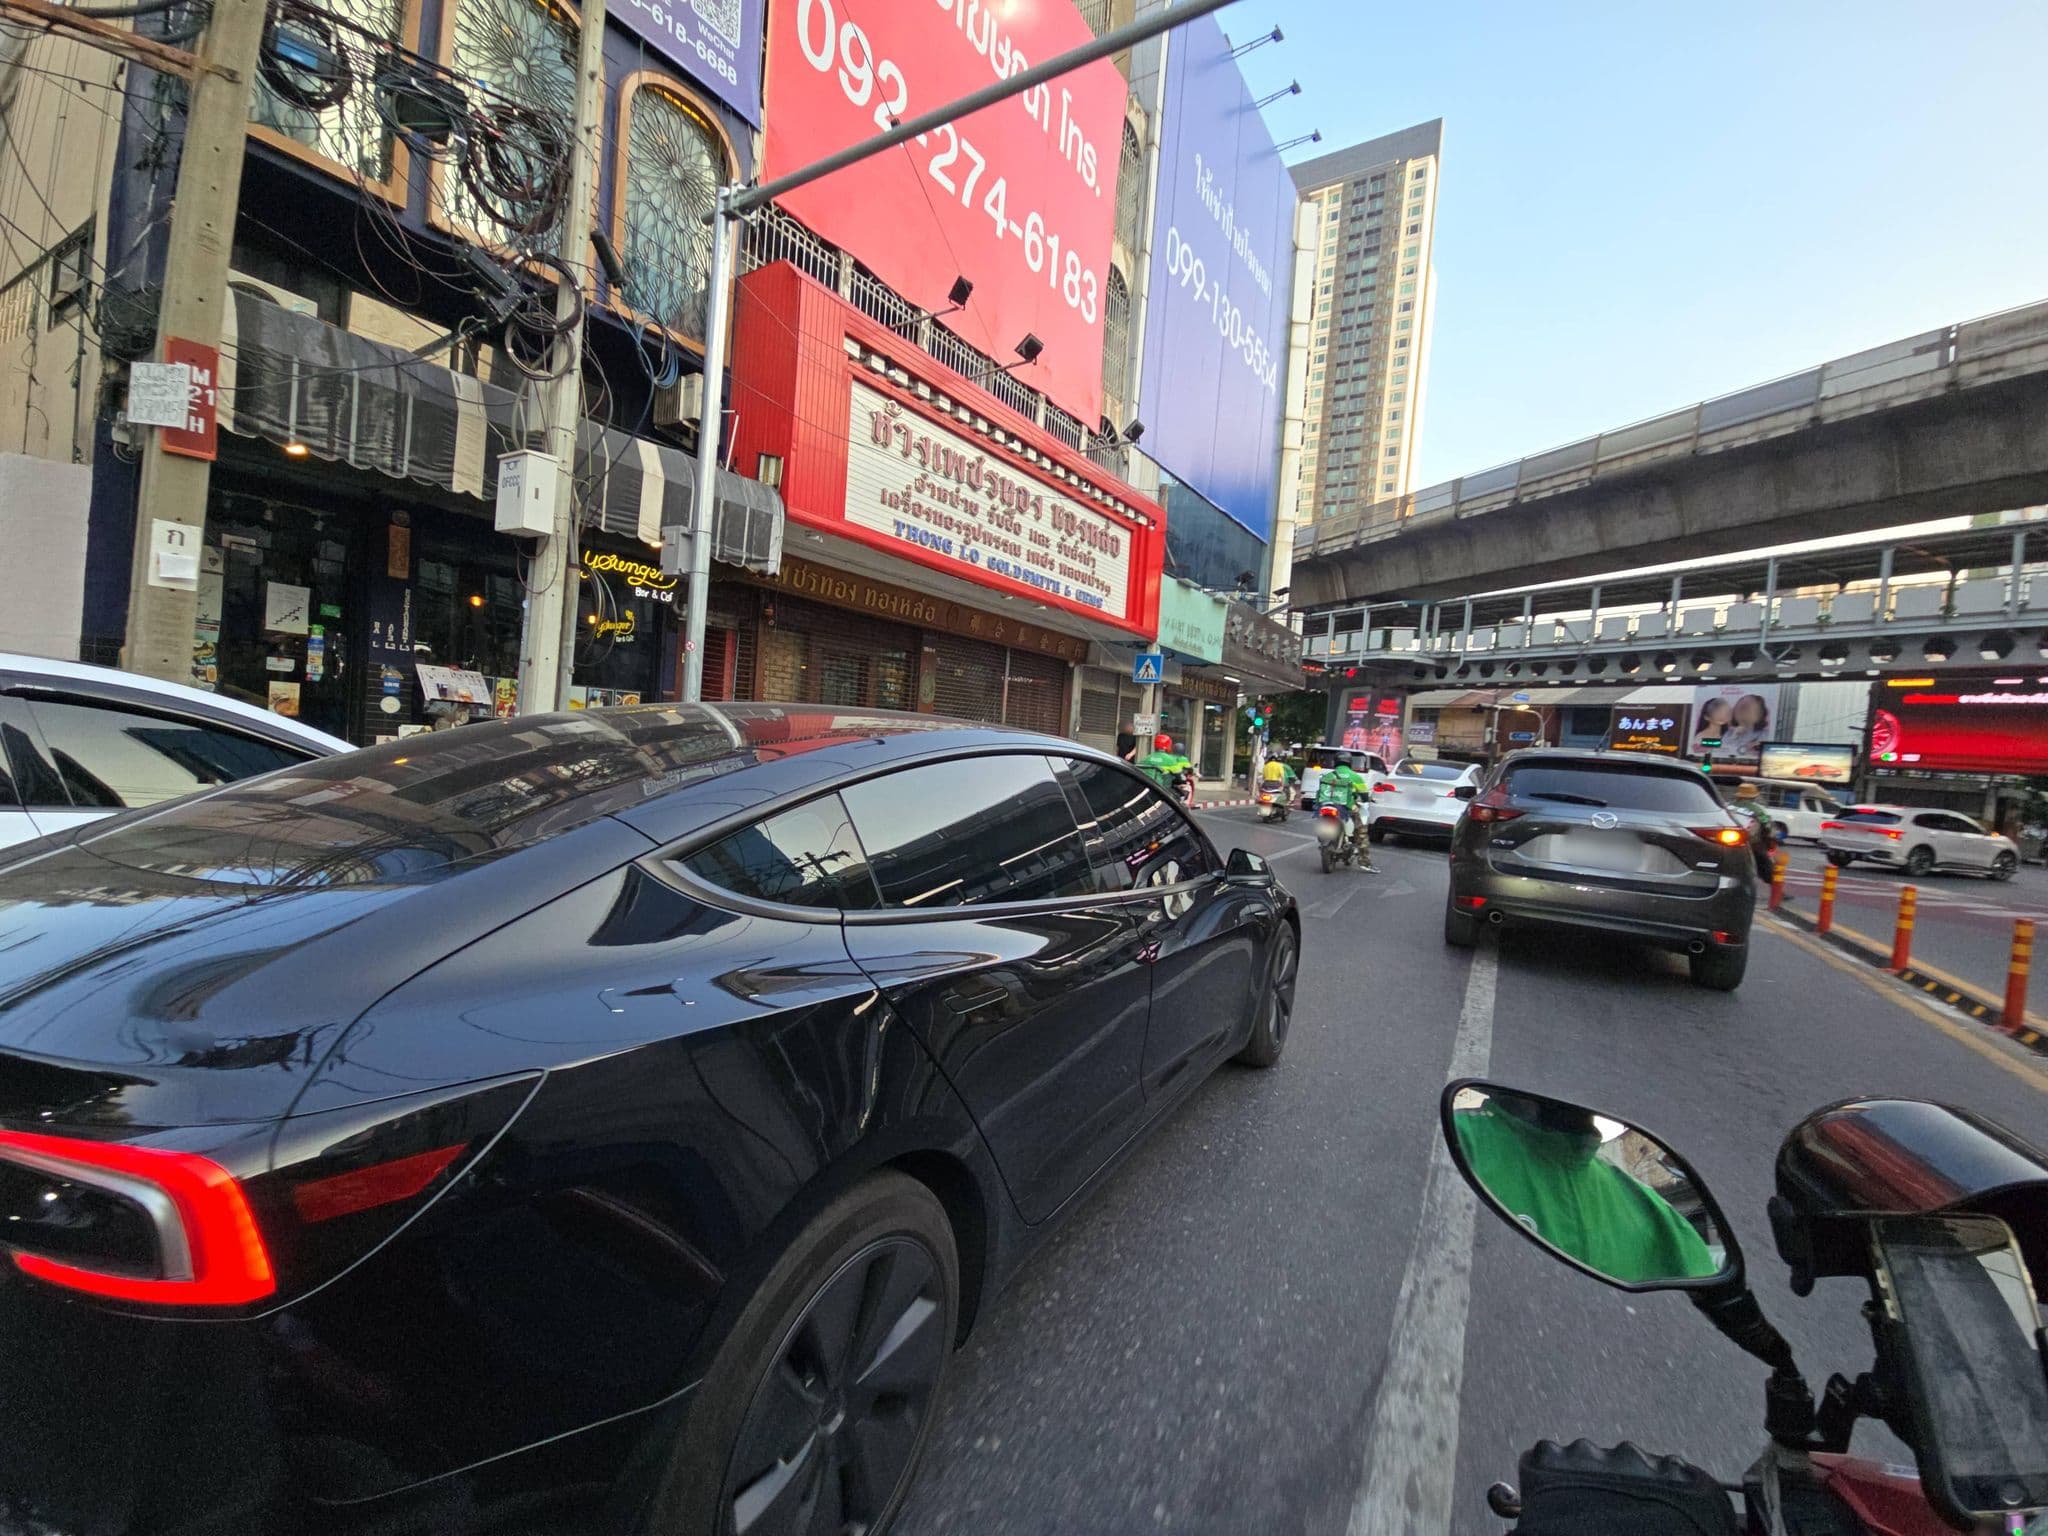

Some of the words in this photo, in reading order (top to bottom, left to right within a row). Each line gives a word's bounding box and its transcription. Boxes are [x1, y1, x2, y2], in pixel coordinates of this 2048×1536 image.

[697, 21, 736, 62] WeChat
[936, 0, 1050, 133] ฆษณา
[1057, 88, 1102, 199] โทร.
[1166, 226, 1278, 396] 099-130-5554
[870, 399, 1043, 521] ห้างเพชรทอง
[1050, 503, 1121, 558] ทองหล่อ
[635, 586, 650, 599] Bar
[651, 589, 659, 600] &
[775, 565, 857, 602] พชรทอง
[865, 587, 936, 623] ทองหล่อ
[892, 518, 953, 555] THONG
[959, 544, 980, 563] LO
[987, 554, 1061, 594] GOLDSMITH
[1075, 588, 1104, 608] GEMS
[1618, 716, 1675, 731] あんまや
